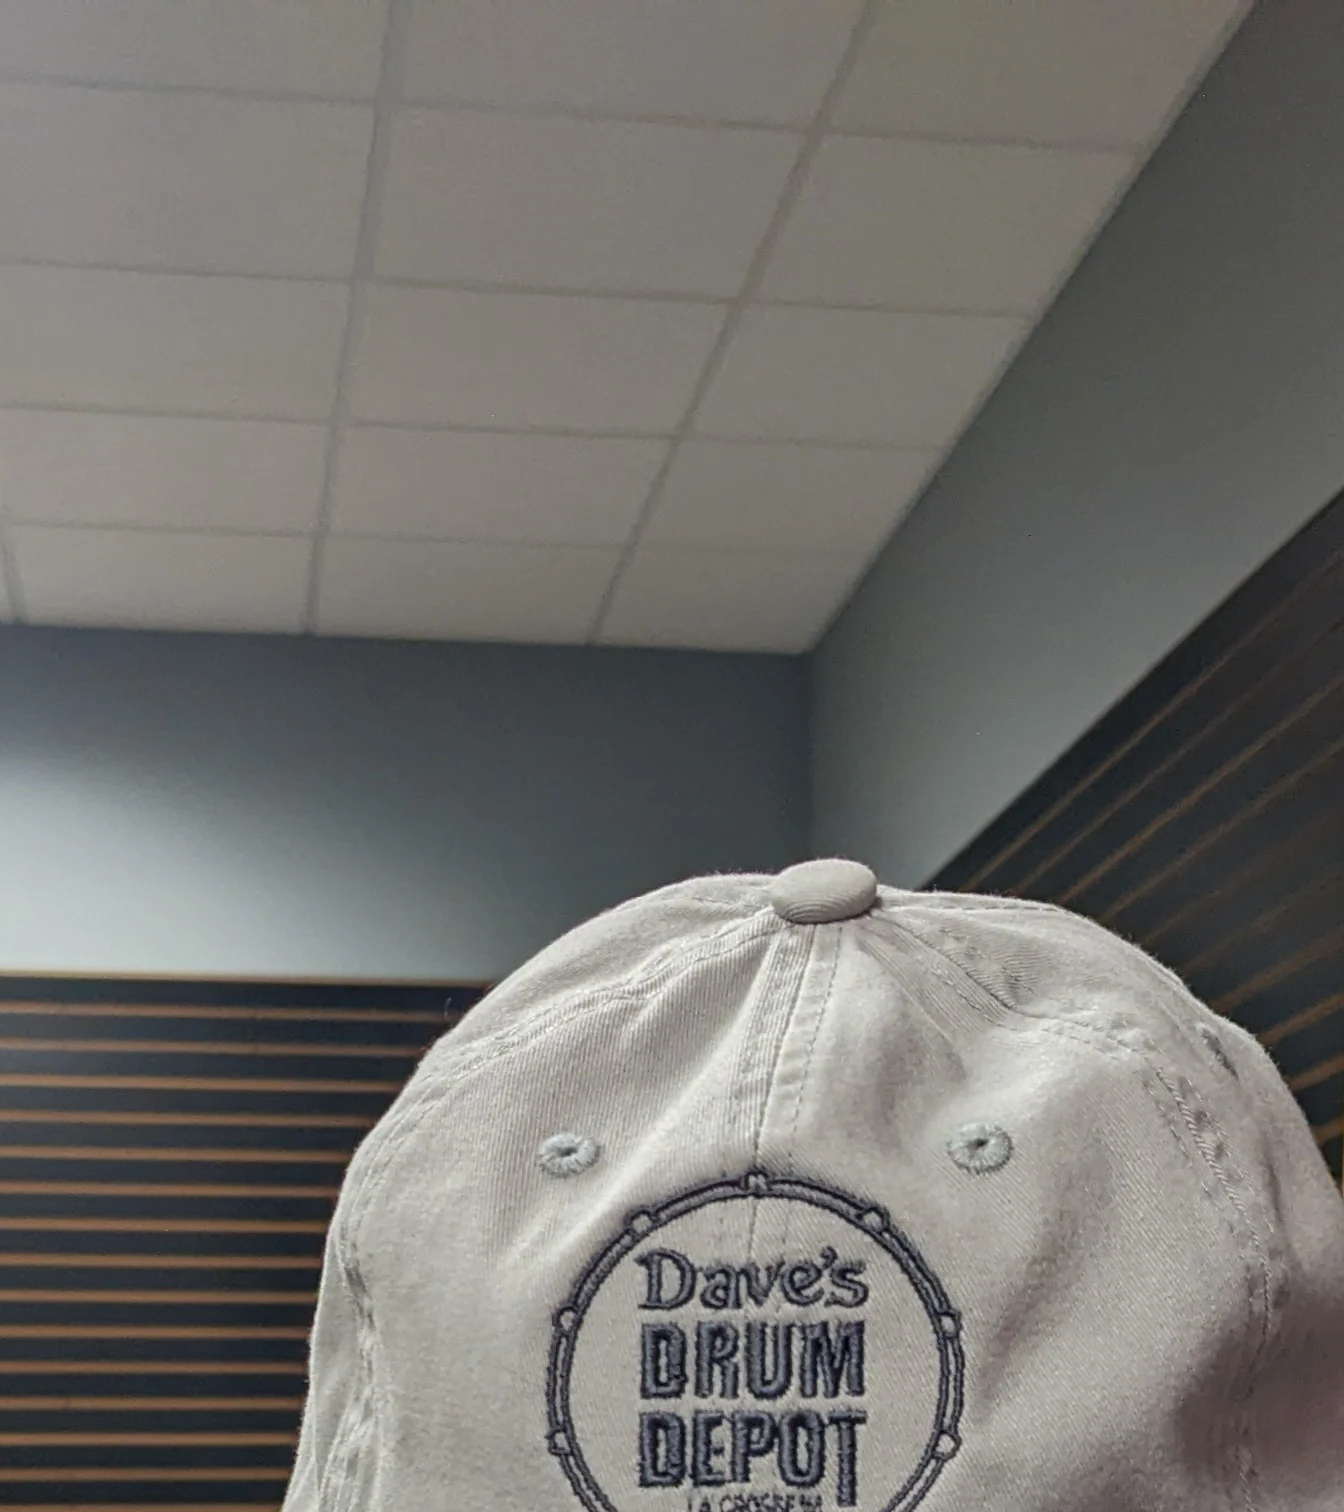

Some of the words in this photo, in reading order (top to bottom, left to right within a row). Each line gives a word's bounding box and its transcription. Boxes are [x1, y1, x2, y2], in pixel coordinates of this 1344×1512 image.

[634, 1245, 870, 1311] Dave's
[639, 1319, 867, 1401] DRUM
[638, 1408, 868, 1508] DEPOT
